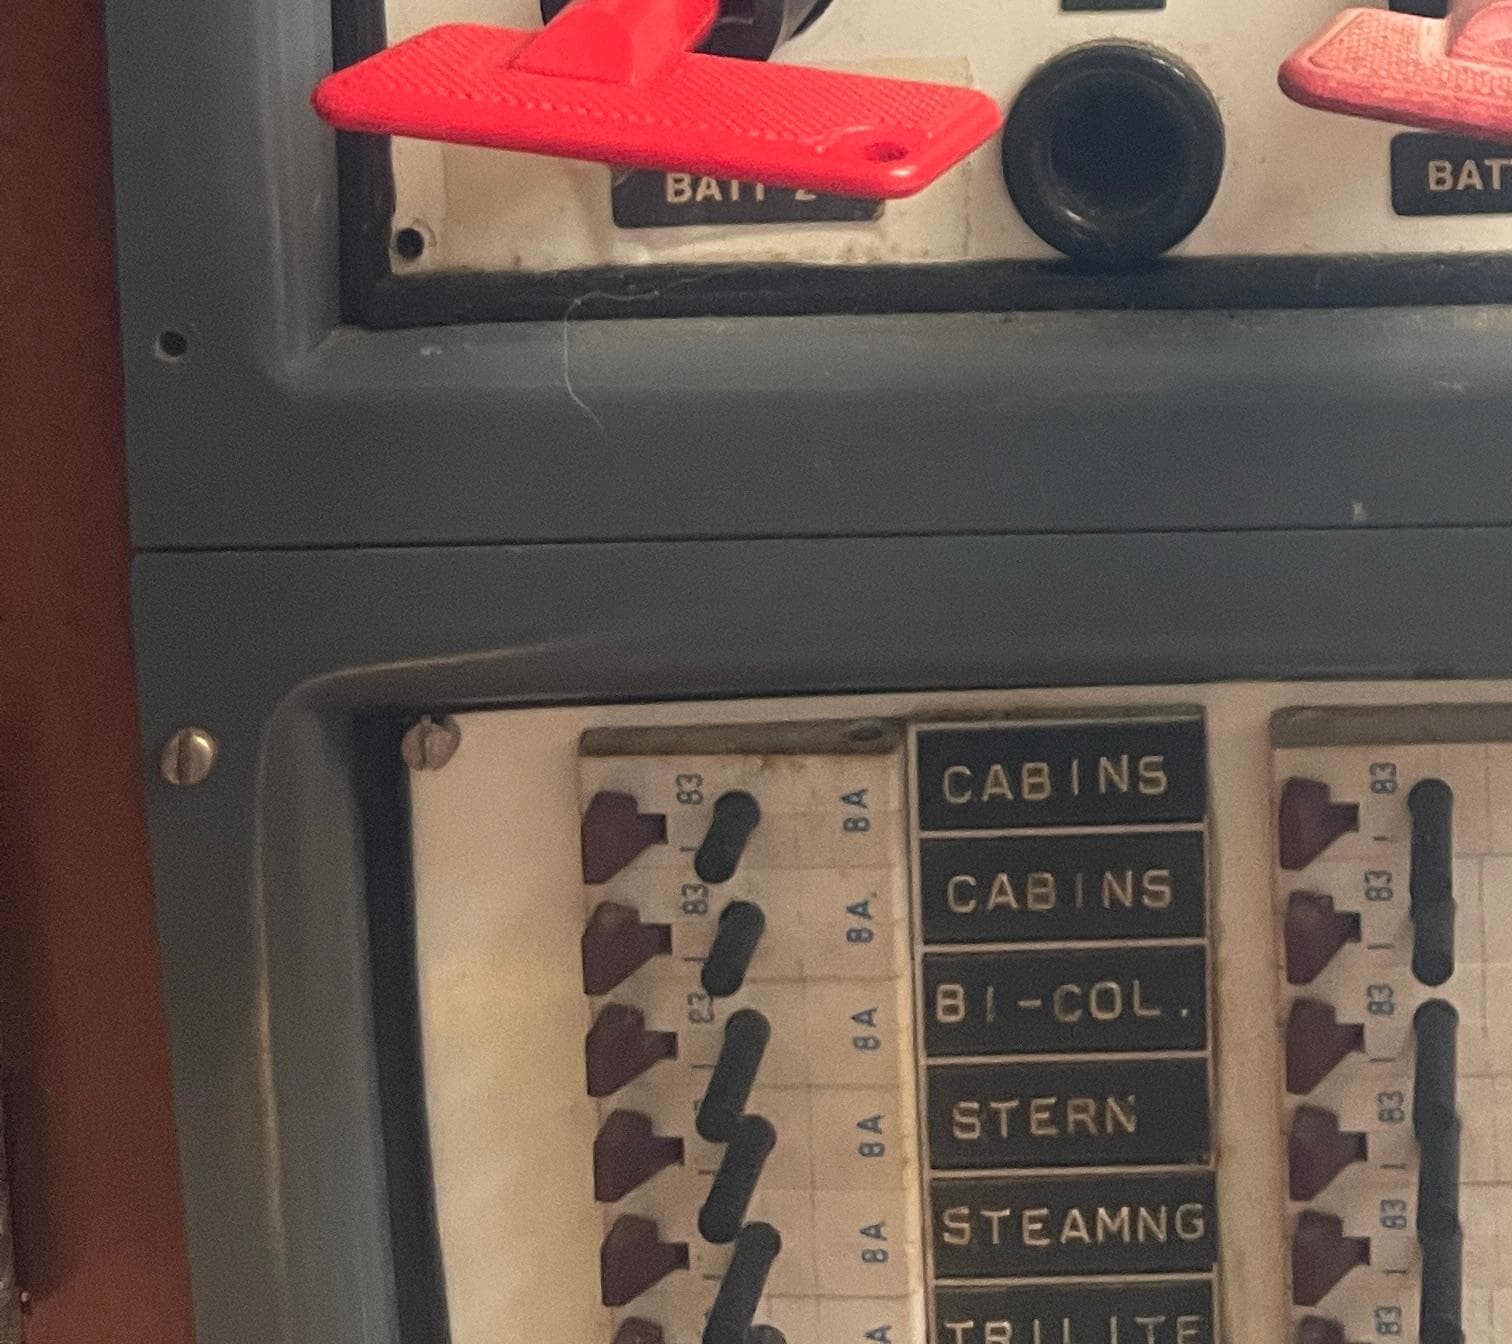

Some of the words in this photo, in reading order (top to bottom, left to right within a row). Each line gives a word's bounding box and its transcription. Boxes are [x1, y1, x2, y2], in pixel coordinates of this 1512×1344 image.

[942, 754, 1169, 806] CABINS
[1369, 761, 1398, 796] 83
[681, 883, 709, 915] 83
[946, 868, 1174, 914] CABINS
[1364, 868, 1394, 902] 83
[1366, 982, 1395, 1016] 83
[951, 1094, 1139, 1142] STERN
[942, 1202, 1205, 1247] STEAMNG
